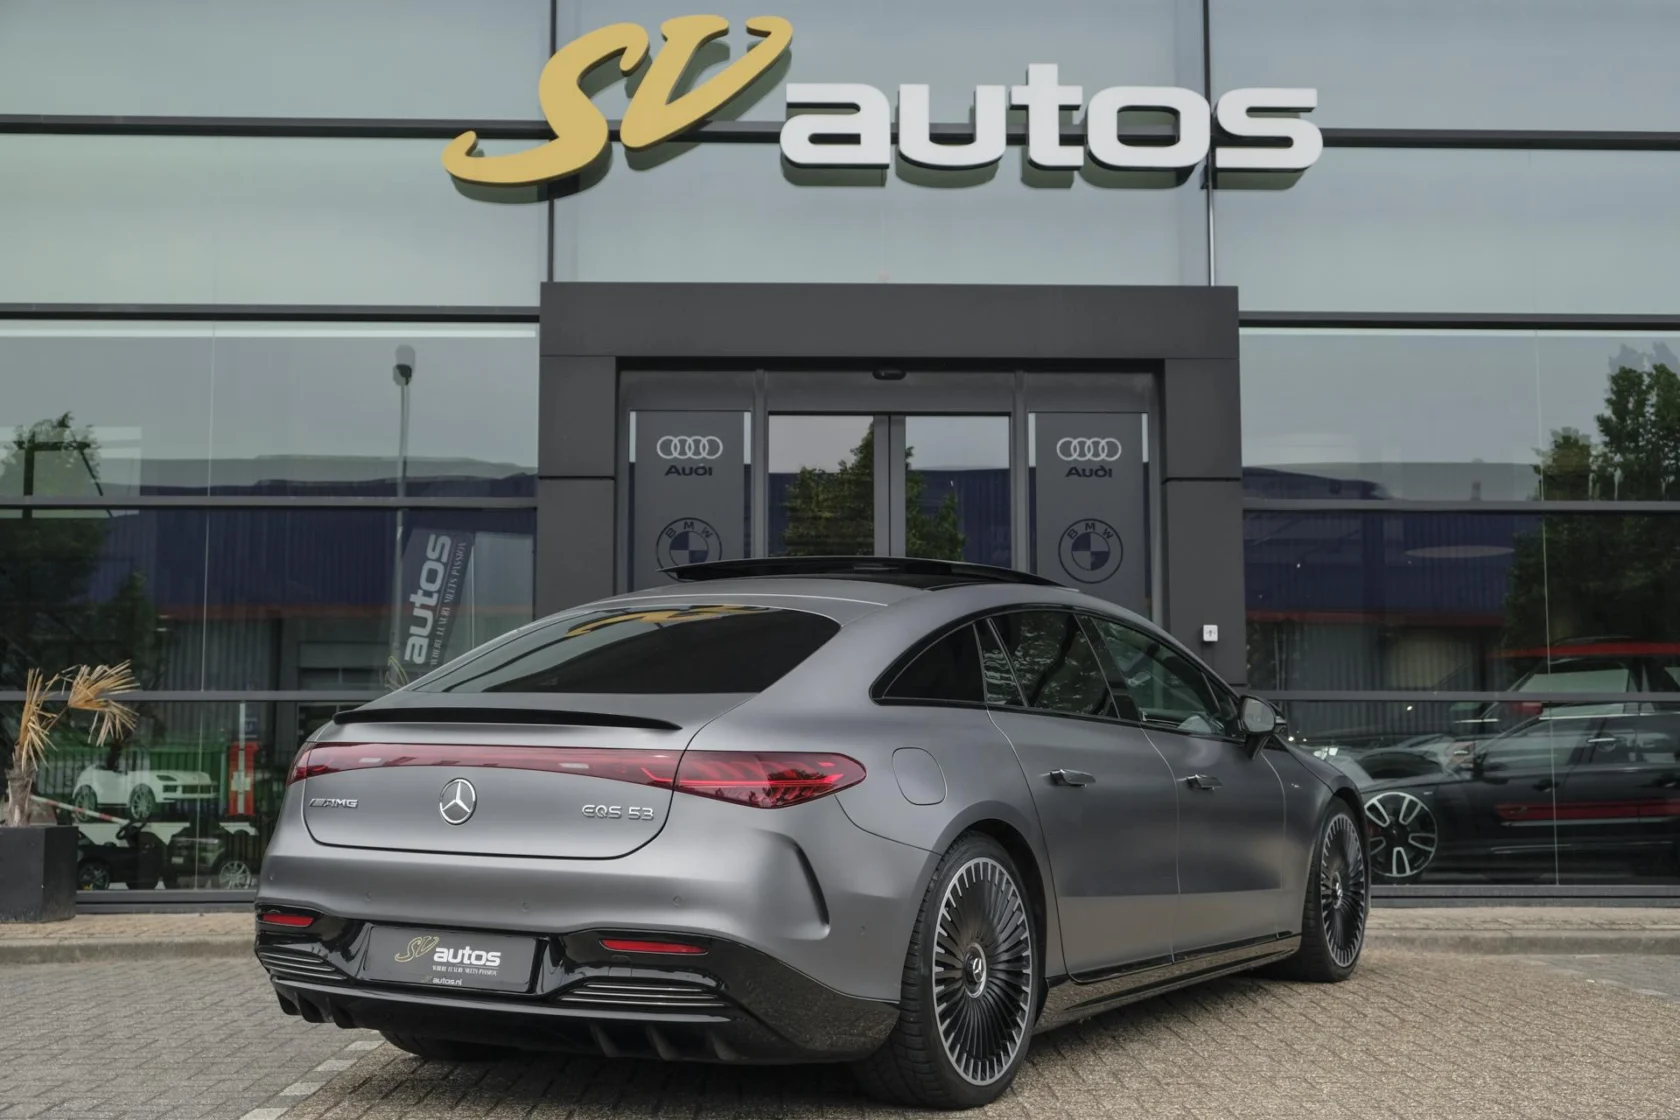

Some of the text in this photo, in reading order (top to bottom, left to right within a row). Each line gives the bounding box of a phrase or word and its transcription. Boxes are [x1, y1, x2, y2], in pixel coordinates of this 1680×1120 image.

[780, 63, 1324, 171] autos
[1065, 465, 1113, 478] Audi
[665, 521, 713, 539] BMW
[1067, 522, 1114, 540] BMW
[404, 534, 451, 664] autos
[322, 798, 358, 808] AMG
[581, 804, 654, 821] EQS 53
[433, 946, 502, 967] autos
